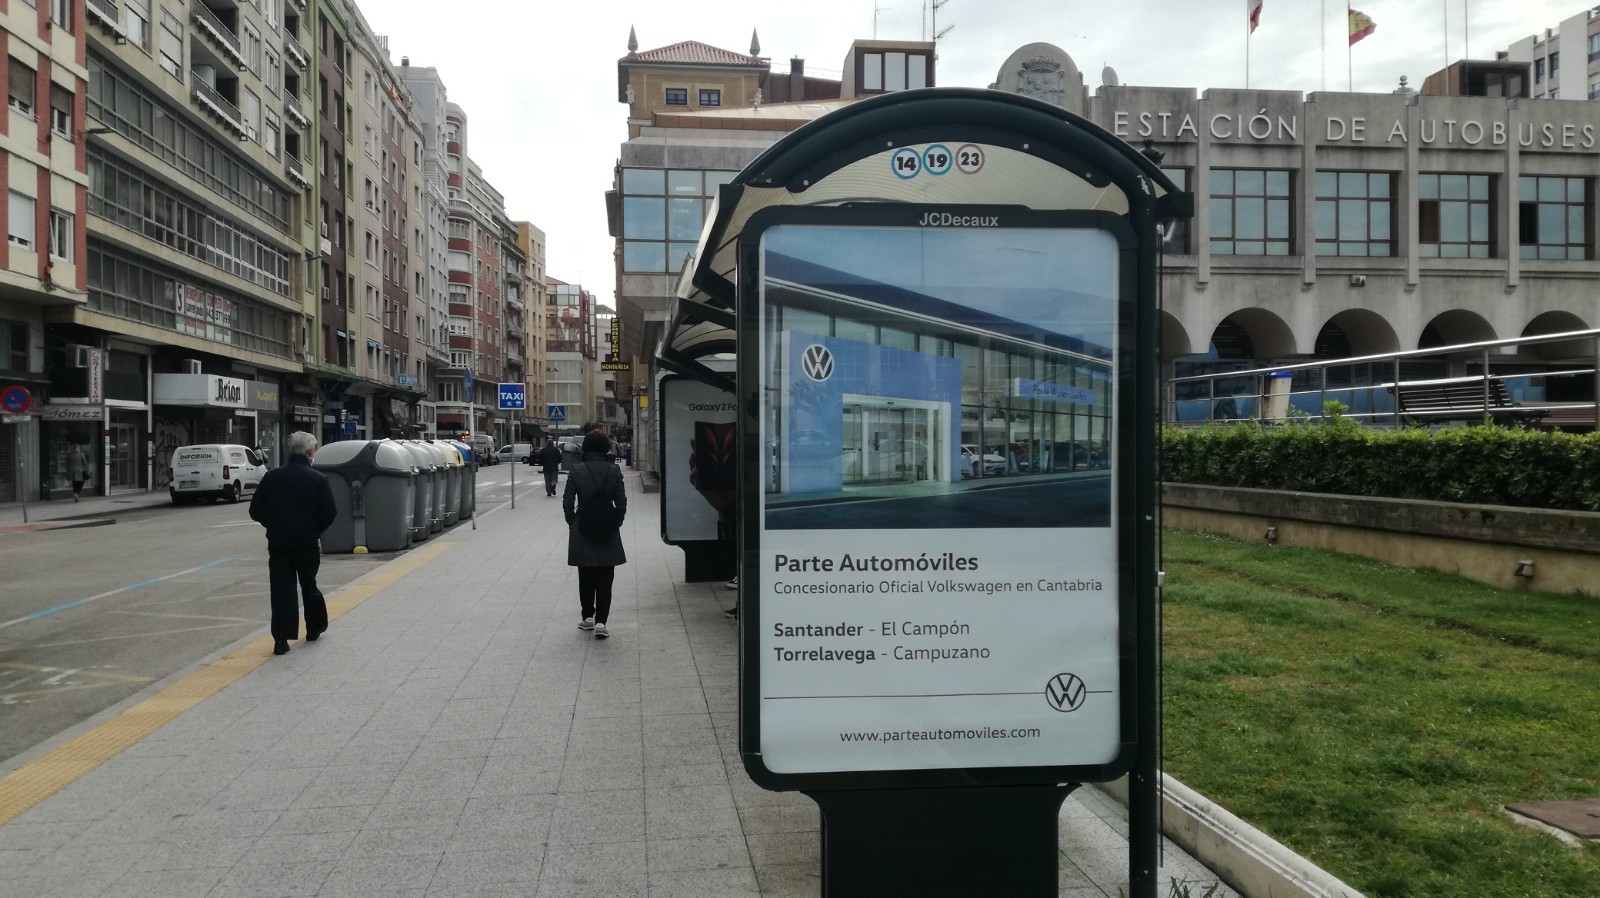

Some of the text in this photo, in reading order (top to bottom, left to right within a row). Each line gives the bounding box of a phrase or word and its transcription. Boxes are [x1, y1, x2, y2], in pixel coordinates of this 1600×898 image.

[1114, 108, 1595, 148] ESTACIÓN DE AUTOBUSES
[896, 151, 980, 171] 14 19 23
[919, 212, 999, 227] JCDecaux
[215, 379, 241, 402] Brion
[500, 392, 524, 400] TAXI
[688, 403, 720, 413] Galaxy
[721, 403, 727, 411] Z
[774, 552, 979, 573] Parte Automóviles
[774, 578, 1103, 596] Concesionario Oficial Volkswagen en Cantabria
[774, 621, 864, 638] Santander
[881, 621, 897, 636] El
[901, 619, 970, 639] Campón
[774, 645, 876, 665] Torrelavega
[893, 645, 991, 664] Campuzano
[839, 725, 1041, 744] www.parteautomoviles.com
